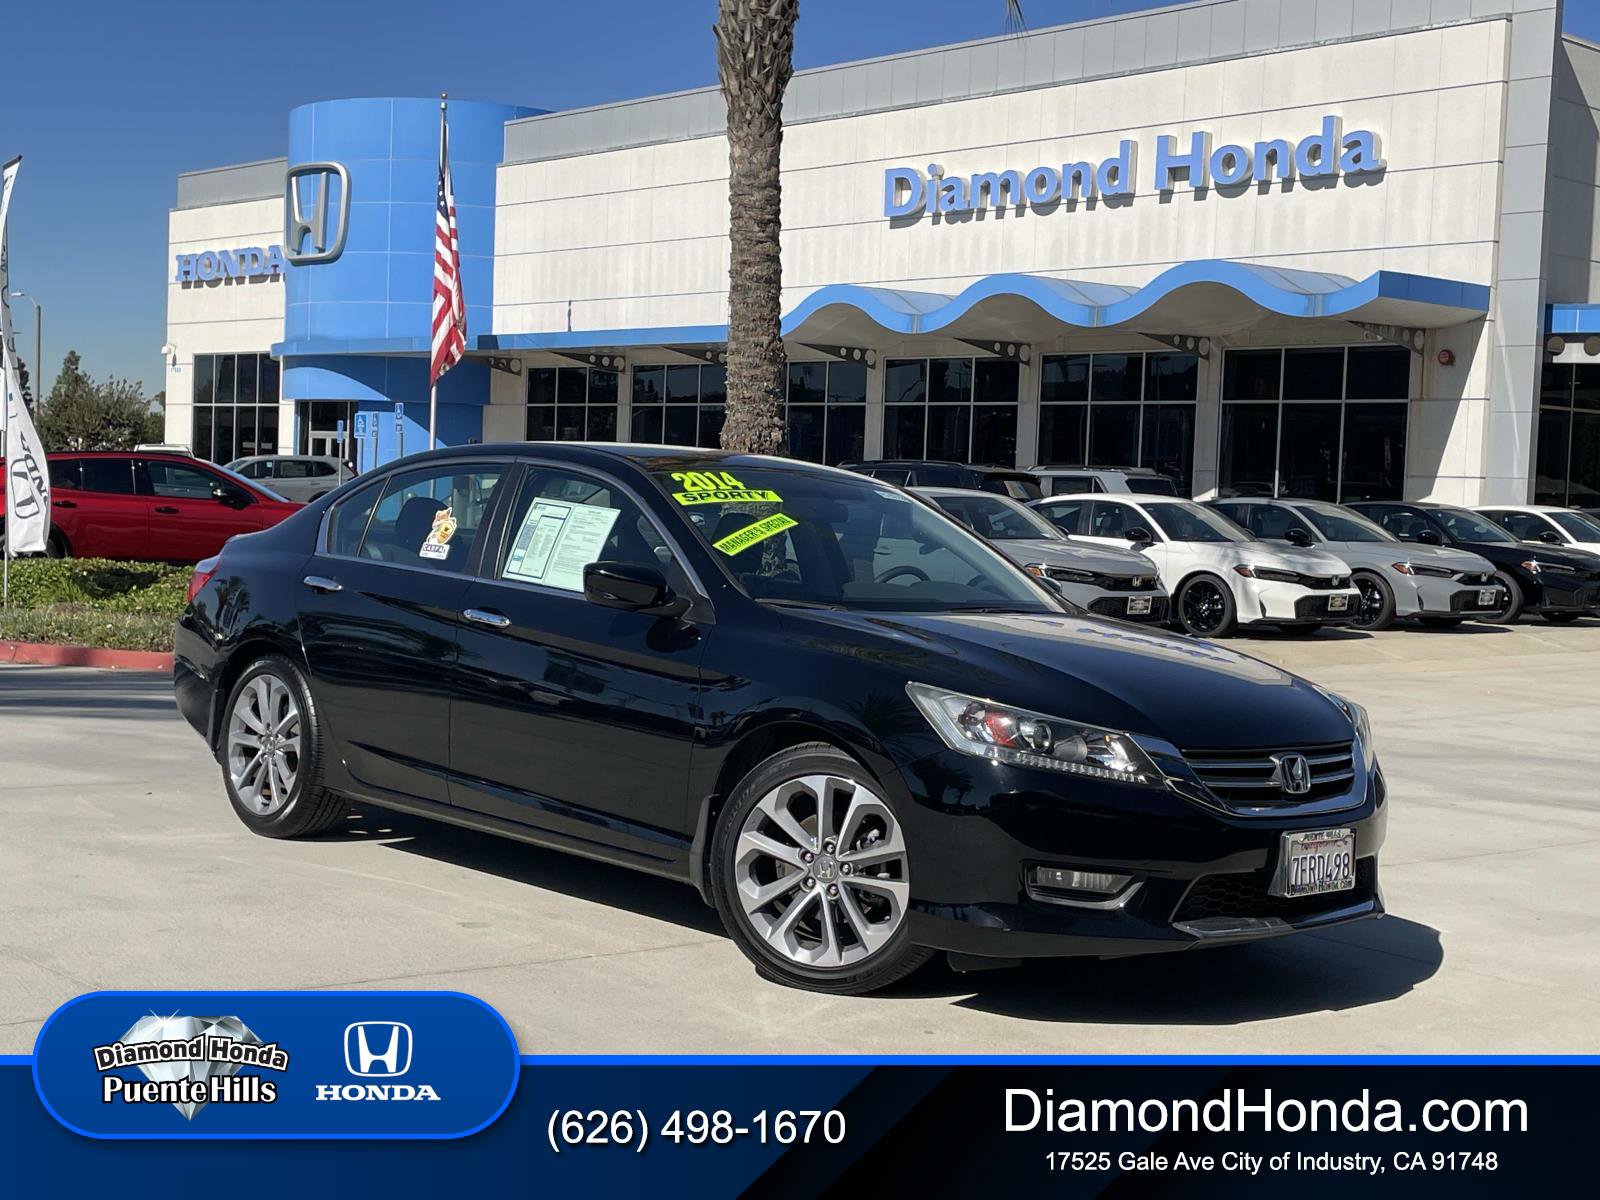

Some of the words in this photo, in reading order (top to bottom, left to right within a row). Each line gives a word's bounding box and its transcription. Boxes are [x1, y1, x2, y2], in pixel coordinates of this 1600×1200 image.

[884, 139, 1135, 218] Diamond
[1154, 115, 1384, 190] Honda
[175, 245, 284, 281] HONDA
[671, 471, 747, 492] 2014
[681, 490, 768, 503] SPORTY
[718, 526, 764, 553] MANAGER'S
[761, 515, 791, 534] SPECIAL
[1292, 854, 1350, 884] 7FRD498
